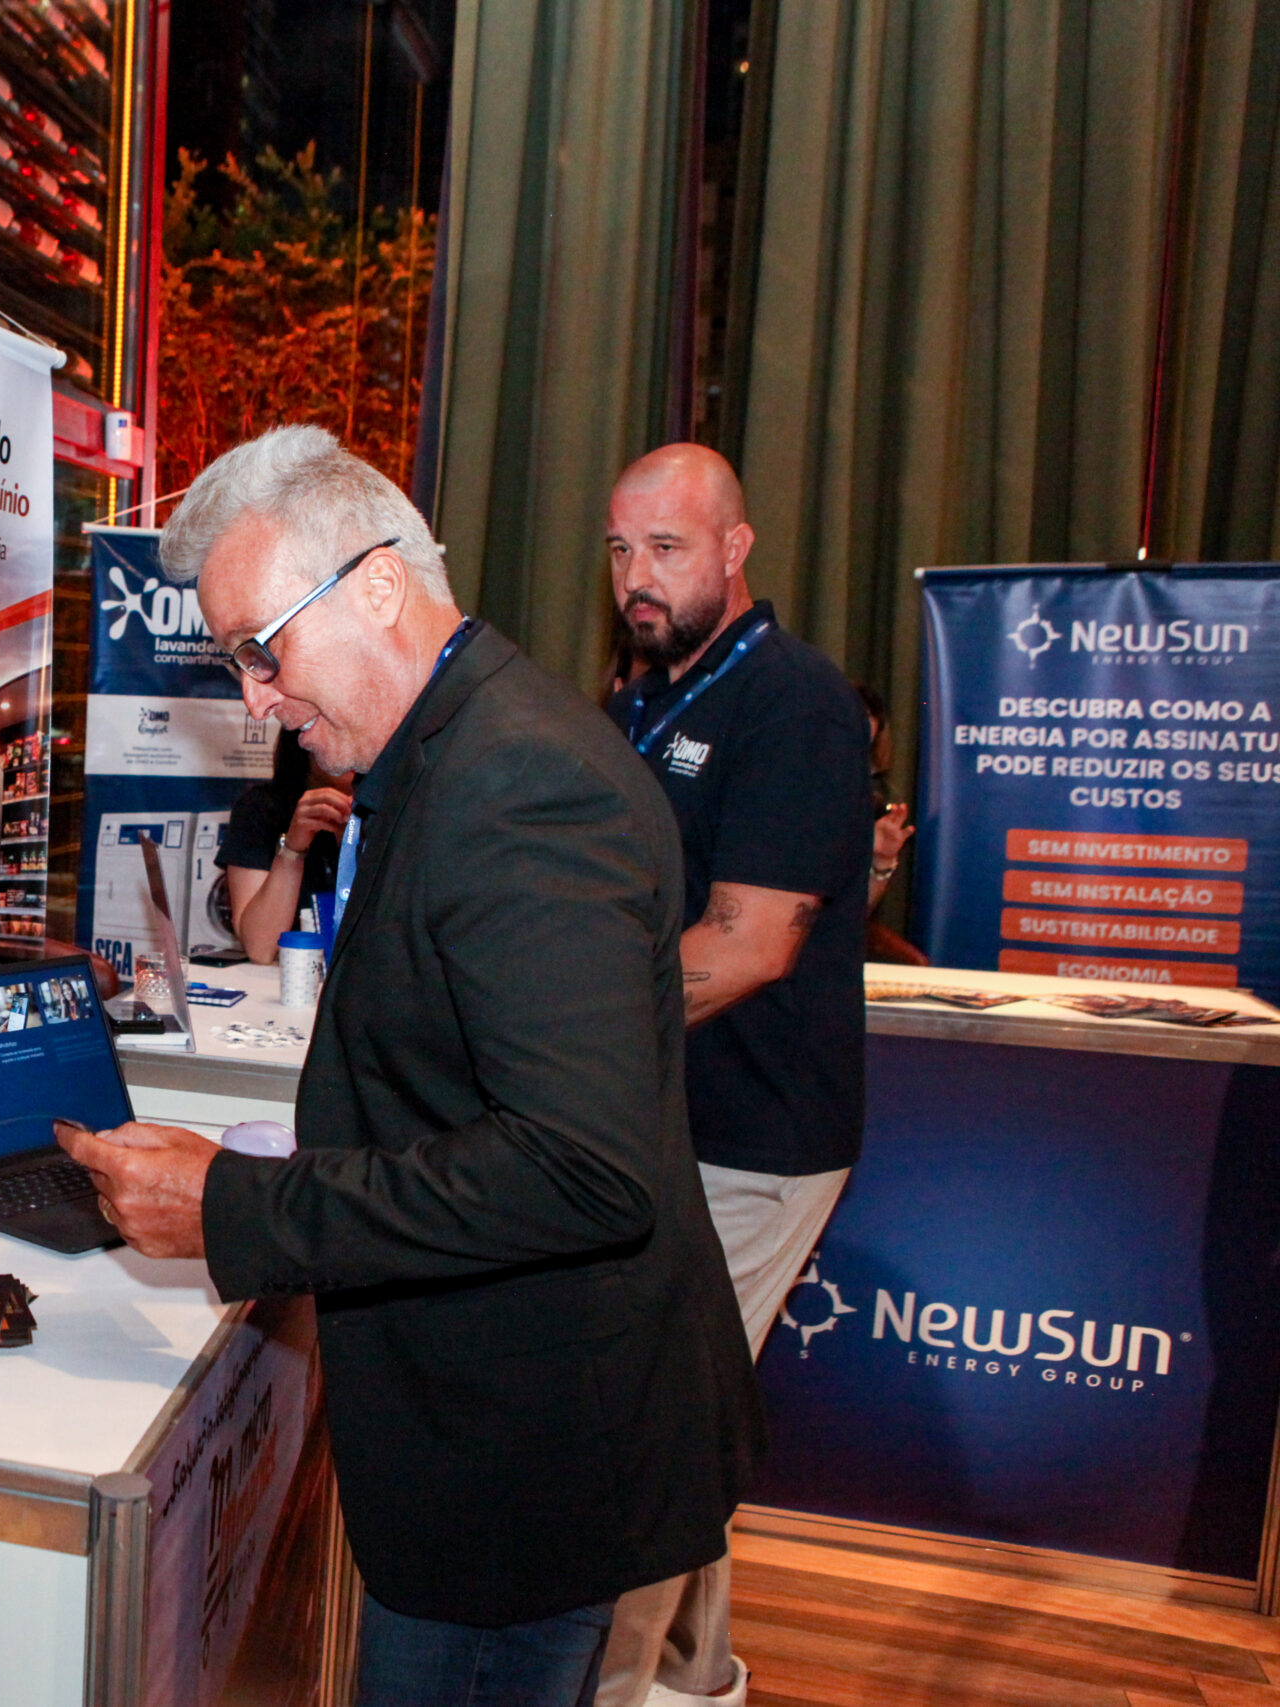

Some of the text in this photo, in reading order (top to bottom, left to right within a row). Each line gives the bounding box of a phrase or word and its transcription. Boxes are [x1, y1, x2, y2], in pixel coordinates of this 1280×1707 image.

[151, 586, 216, 636] OM
[1071, 619, 1249, 653] NewSun
[1091, 654, 1235, 666] ENERGY GROUP
[999, 697, 1272, 722] DESCUBRA COMO A
[954, 724, 1279, 752] ENERGIA POR ASSINATU
[977, 754, 1046, 776] PODE
[1052, 757, 1166, 779] REDUZIR
[1171, 760, 1211, 781] OS
[1070, 787, 1183, 809] CUSTOS
[347, 819, 356, 845] Gabor
[1028, 839, 1231, 864] SEM INVESTIMENTO
[1030, 880, 1214, 908] SEM INSTALAÇÃO
[1020, 917, 1219, 944] SUSTENTABILIDADE
[1057, 962, 1172, 984] ECONOMIA
[872, 1288, 1172, 1376] NewSun
[907, 1351, 1145, 1392] ENERGY GROUP
